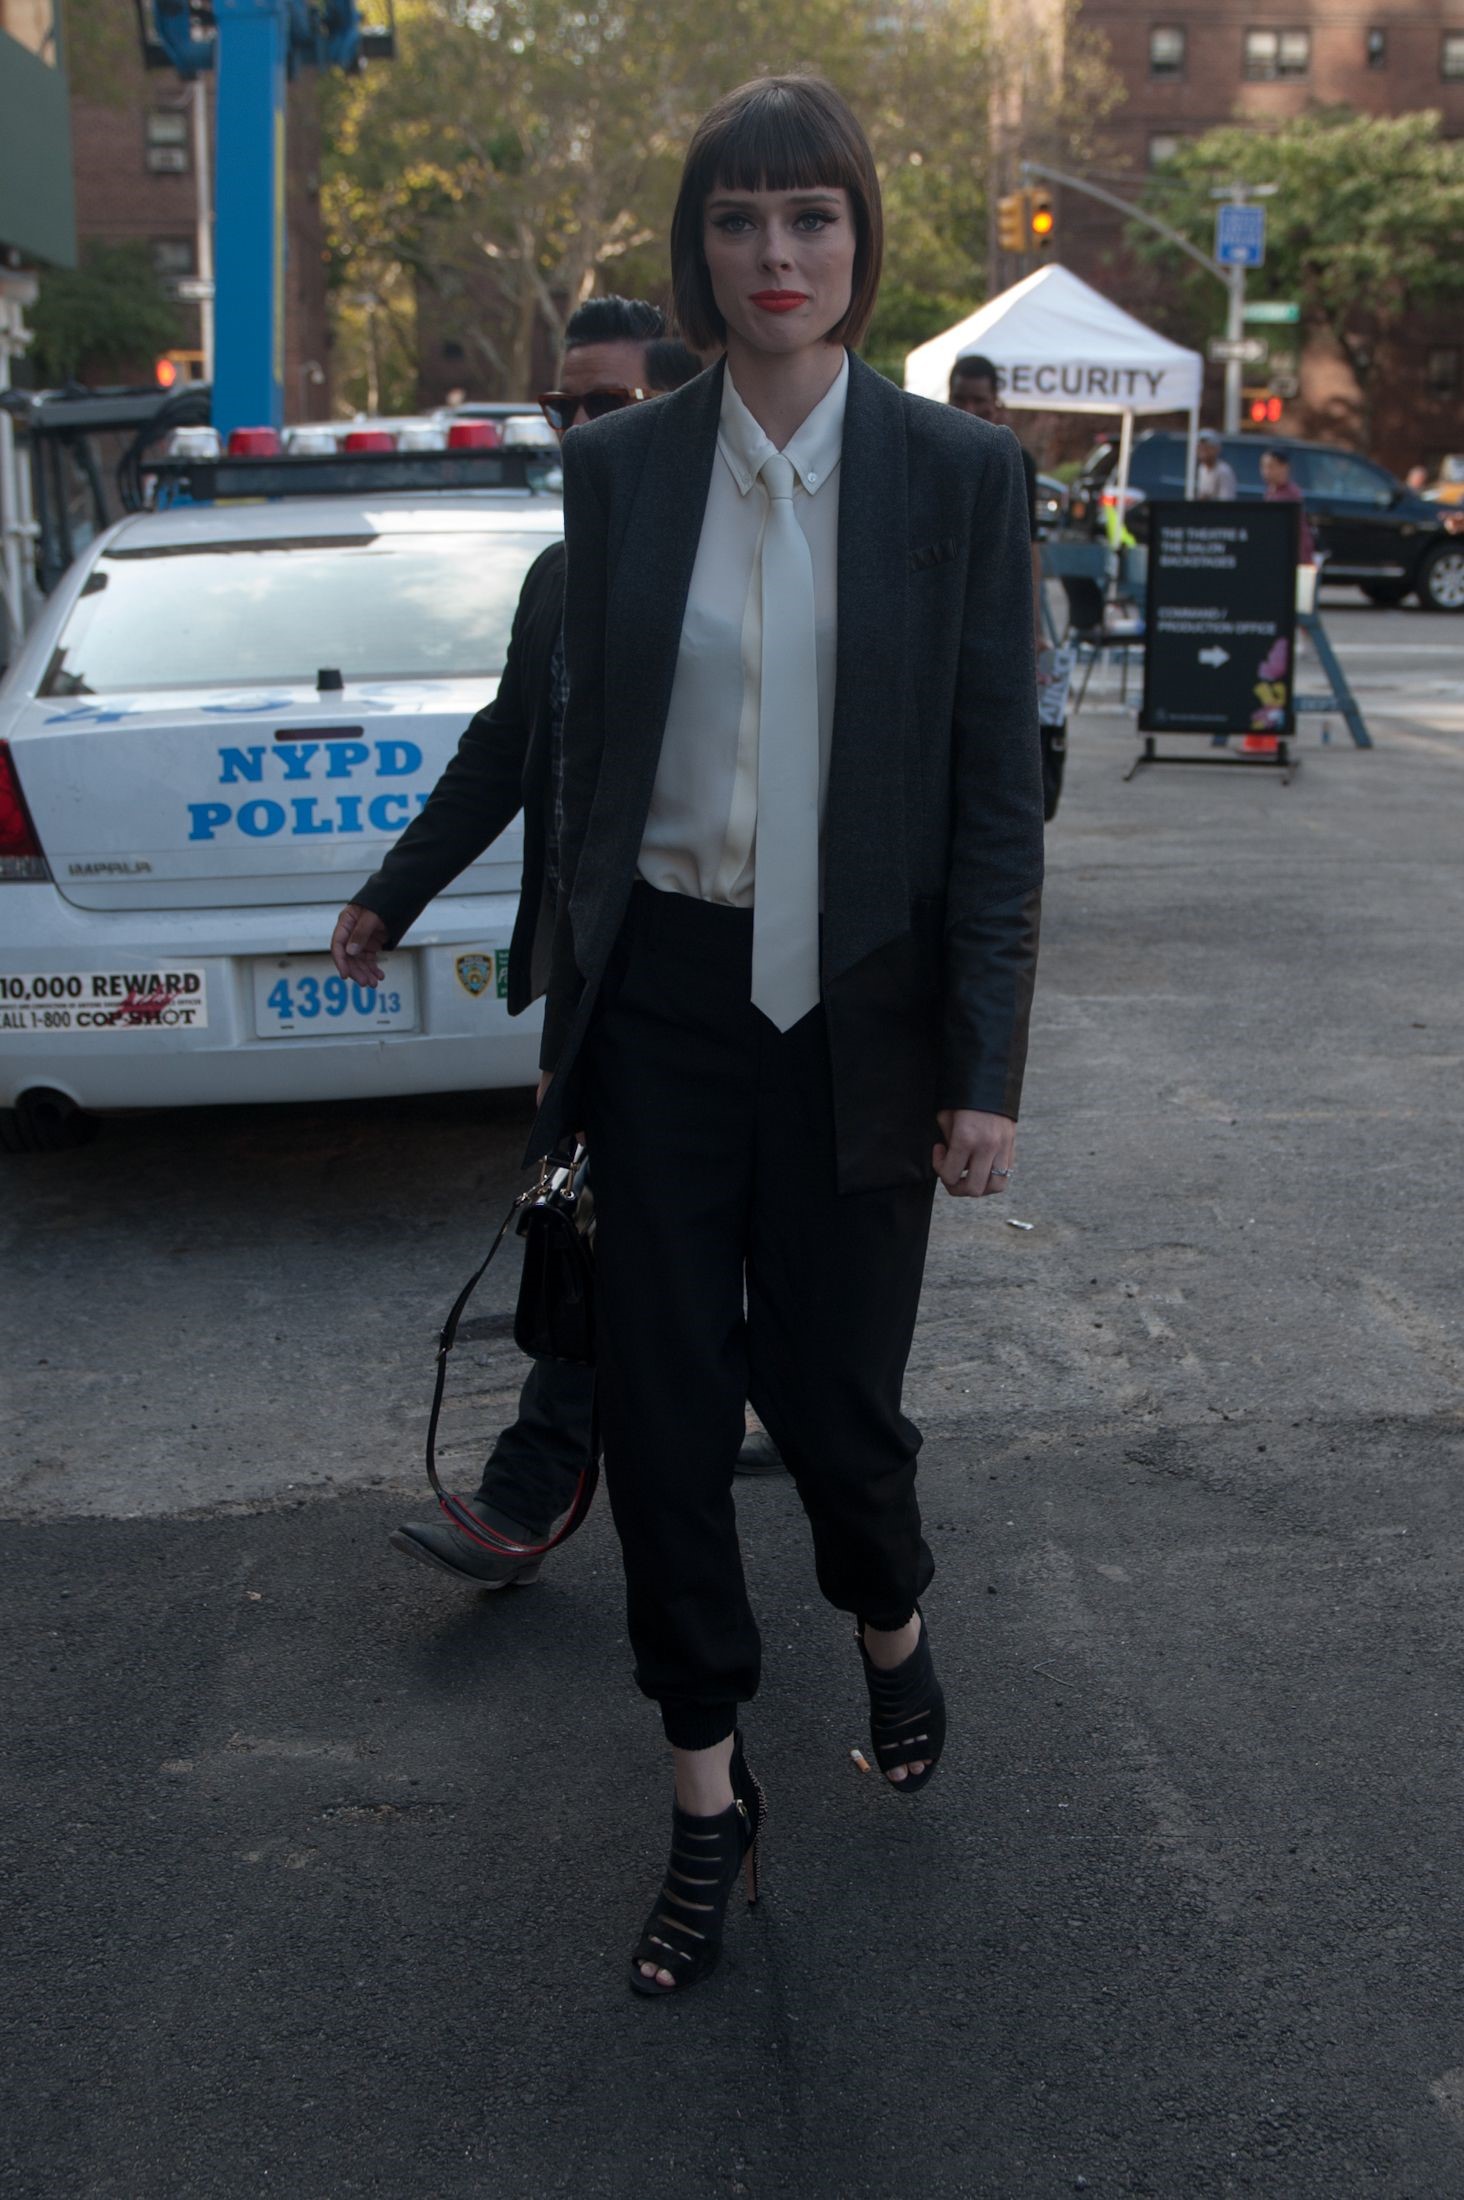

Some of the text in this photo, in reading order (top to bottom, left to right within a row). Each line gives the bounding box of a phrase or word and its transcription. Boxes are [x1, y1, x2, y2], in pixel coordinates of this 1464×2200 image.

[994, 364, 1167, 398] SECURITY
[219, 740, 423, 783] NYPD
[68, 861, 152, 876] IMPALA
[92, 973, 201, 997] REWARD
[267, 975, 401, 1019] 4390 13
[32, 1011, 71, 1028] 1-800
